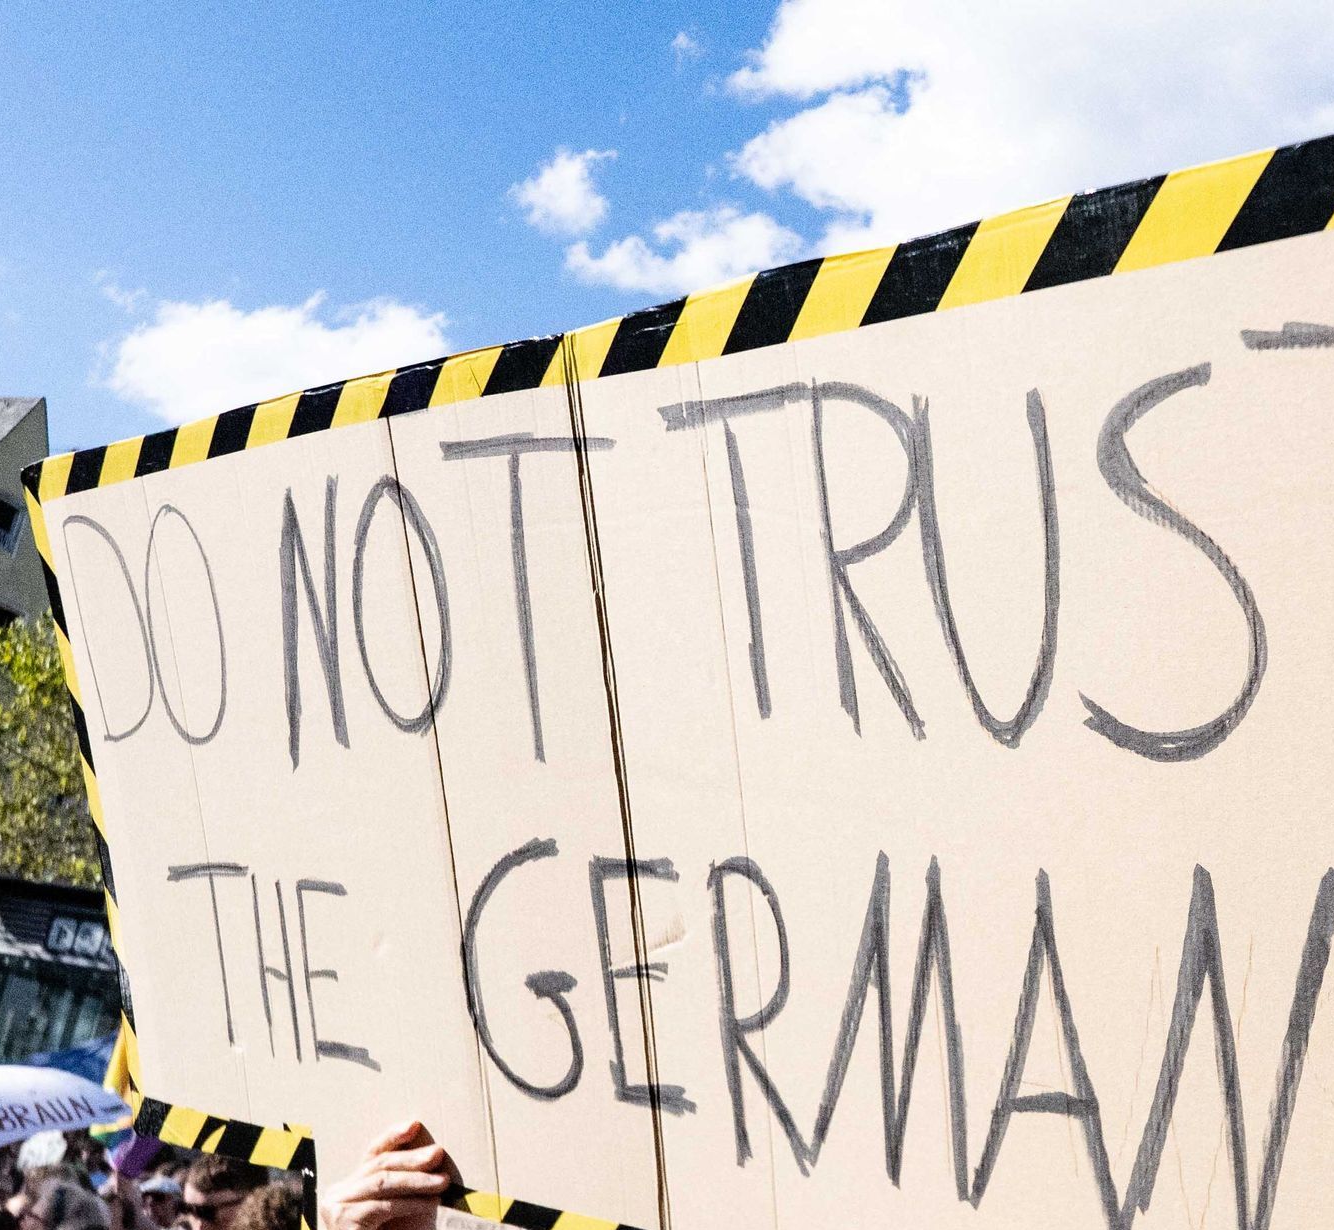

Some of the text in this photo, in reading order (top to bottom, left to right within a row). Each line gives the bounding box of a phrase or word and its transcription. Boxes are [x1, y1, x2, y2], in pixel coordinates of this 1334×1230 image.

[63, 504, 226, 745] DO
[280, 432, 616, 773] NOT
[167, 861, 381, 1072] THE
